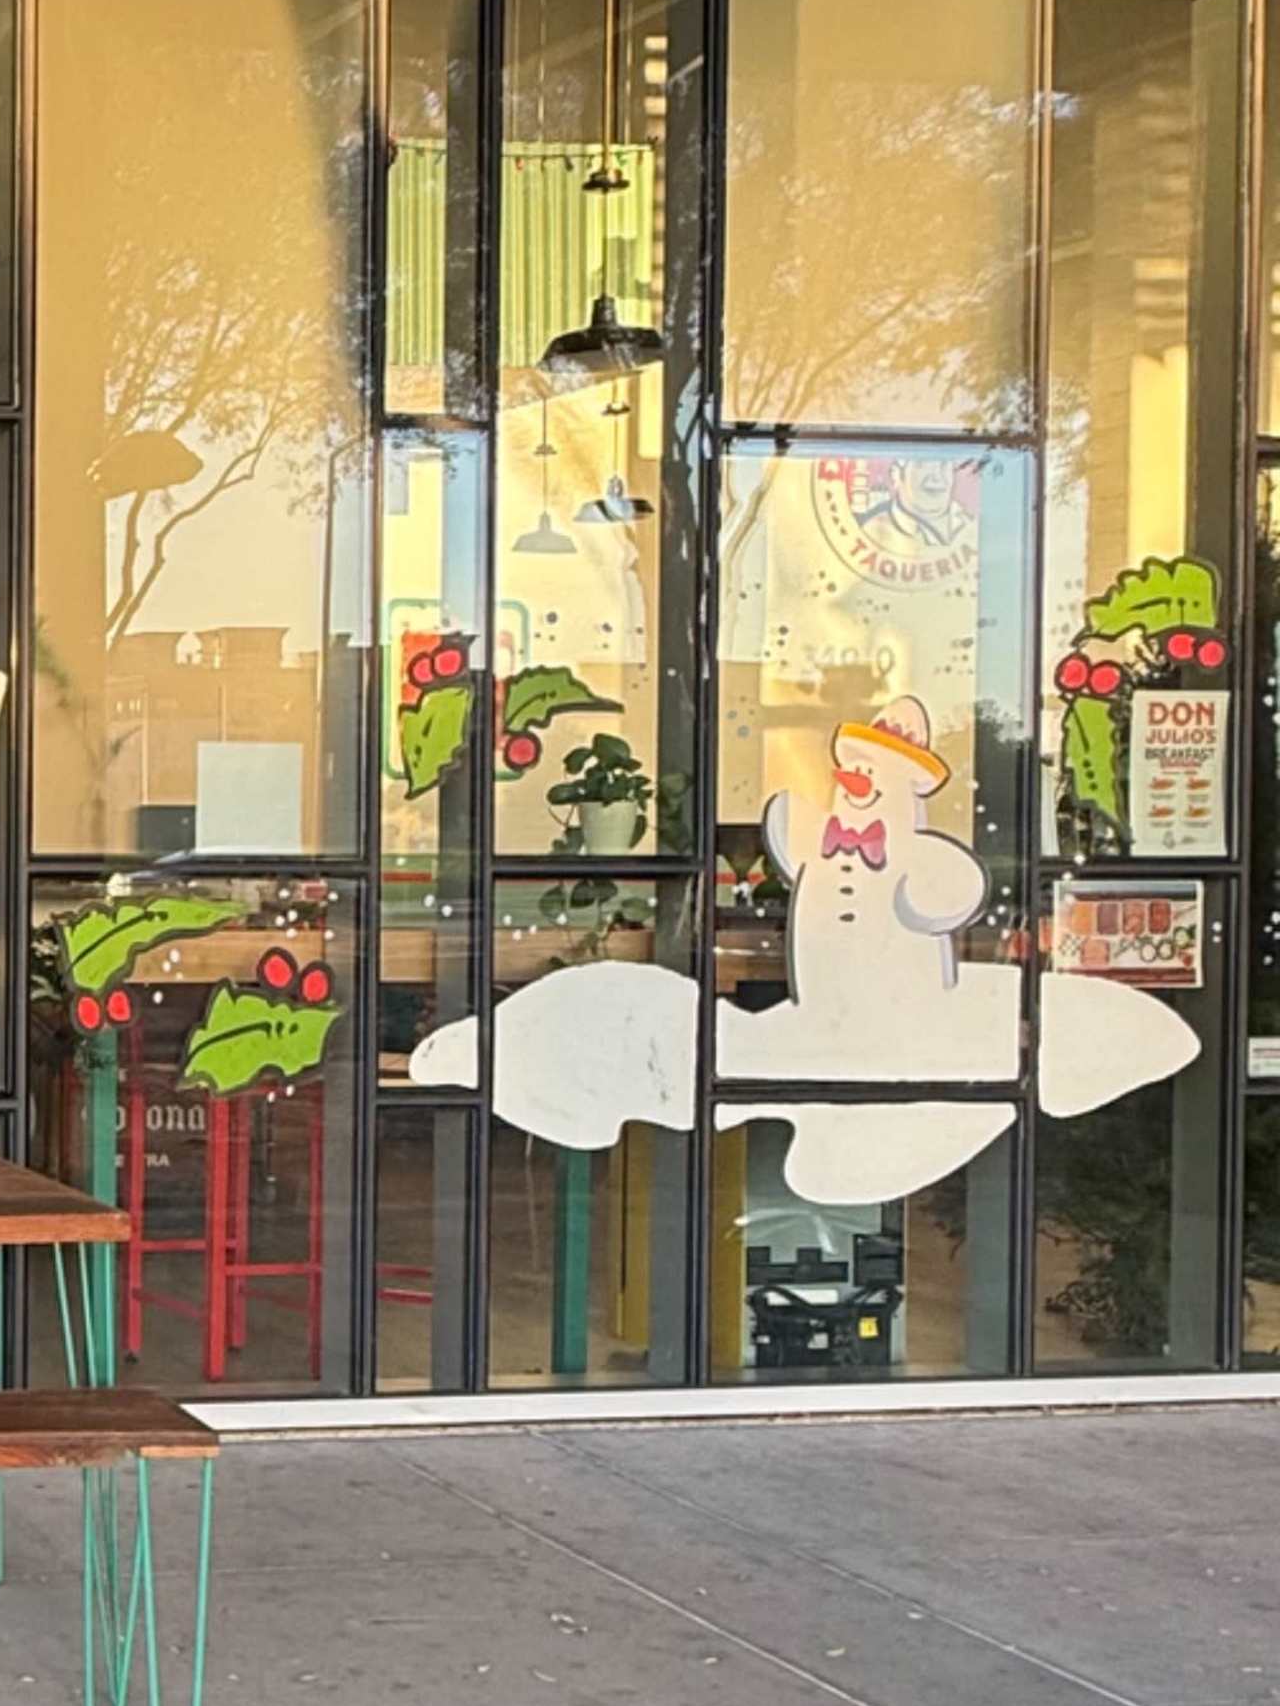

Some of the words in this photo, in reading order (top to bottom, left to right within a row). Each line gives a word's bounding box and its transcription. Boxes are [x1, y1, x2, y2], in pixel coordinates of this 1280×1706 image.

[848, 541, 979, 582] TAQUERIA
[1147, 701, 1216, 726] DON
[1145, 728, 1217, 745] JULIO'S
